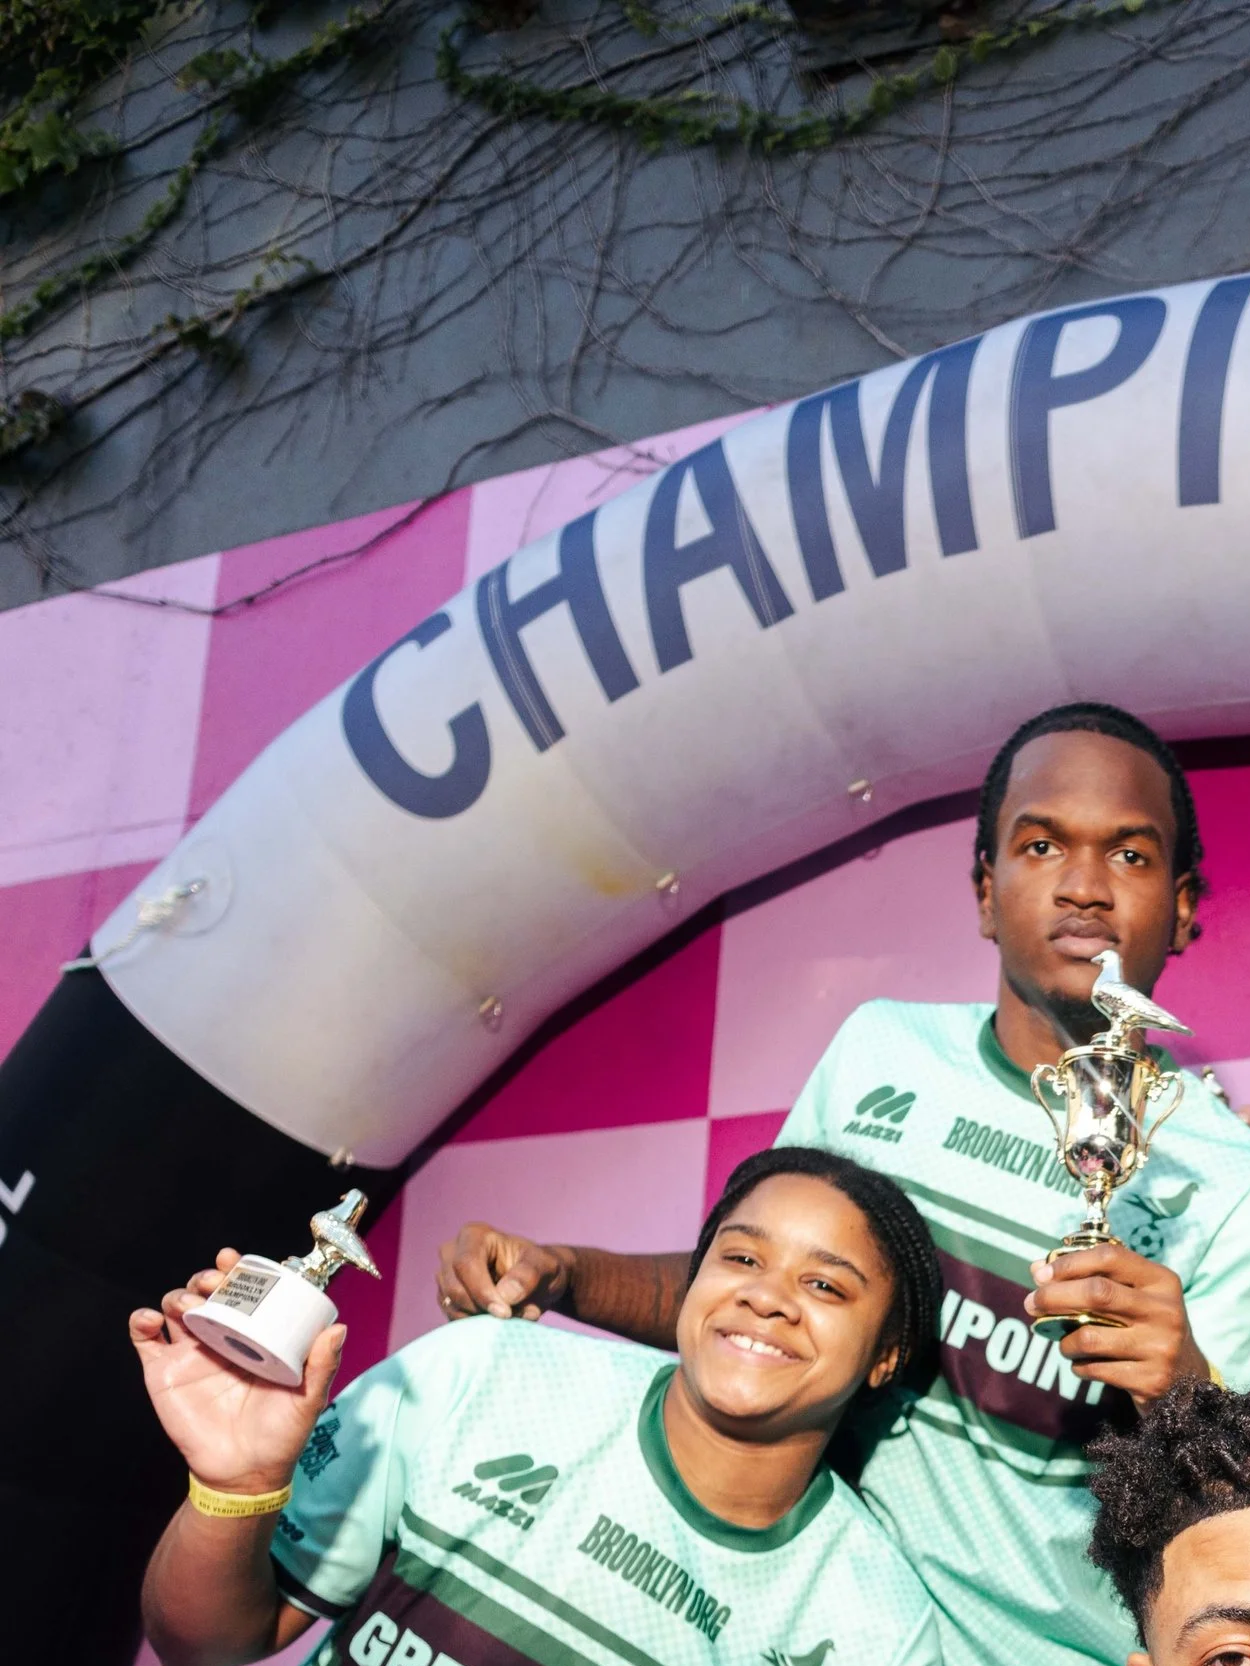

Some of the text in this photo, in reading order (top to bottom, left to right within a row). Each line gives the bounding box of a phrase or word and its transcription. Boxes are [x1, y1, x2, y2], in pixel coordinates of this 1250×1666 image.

[842, 1121, 903, 1144] MAZZI
[942, 1116, 1050, 1183] BROOKLYN
[452, 1481, 536, 1531] MAZZI
[577, 1513, 732, 1645] BROOKLYN ORG
